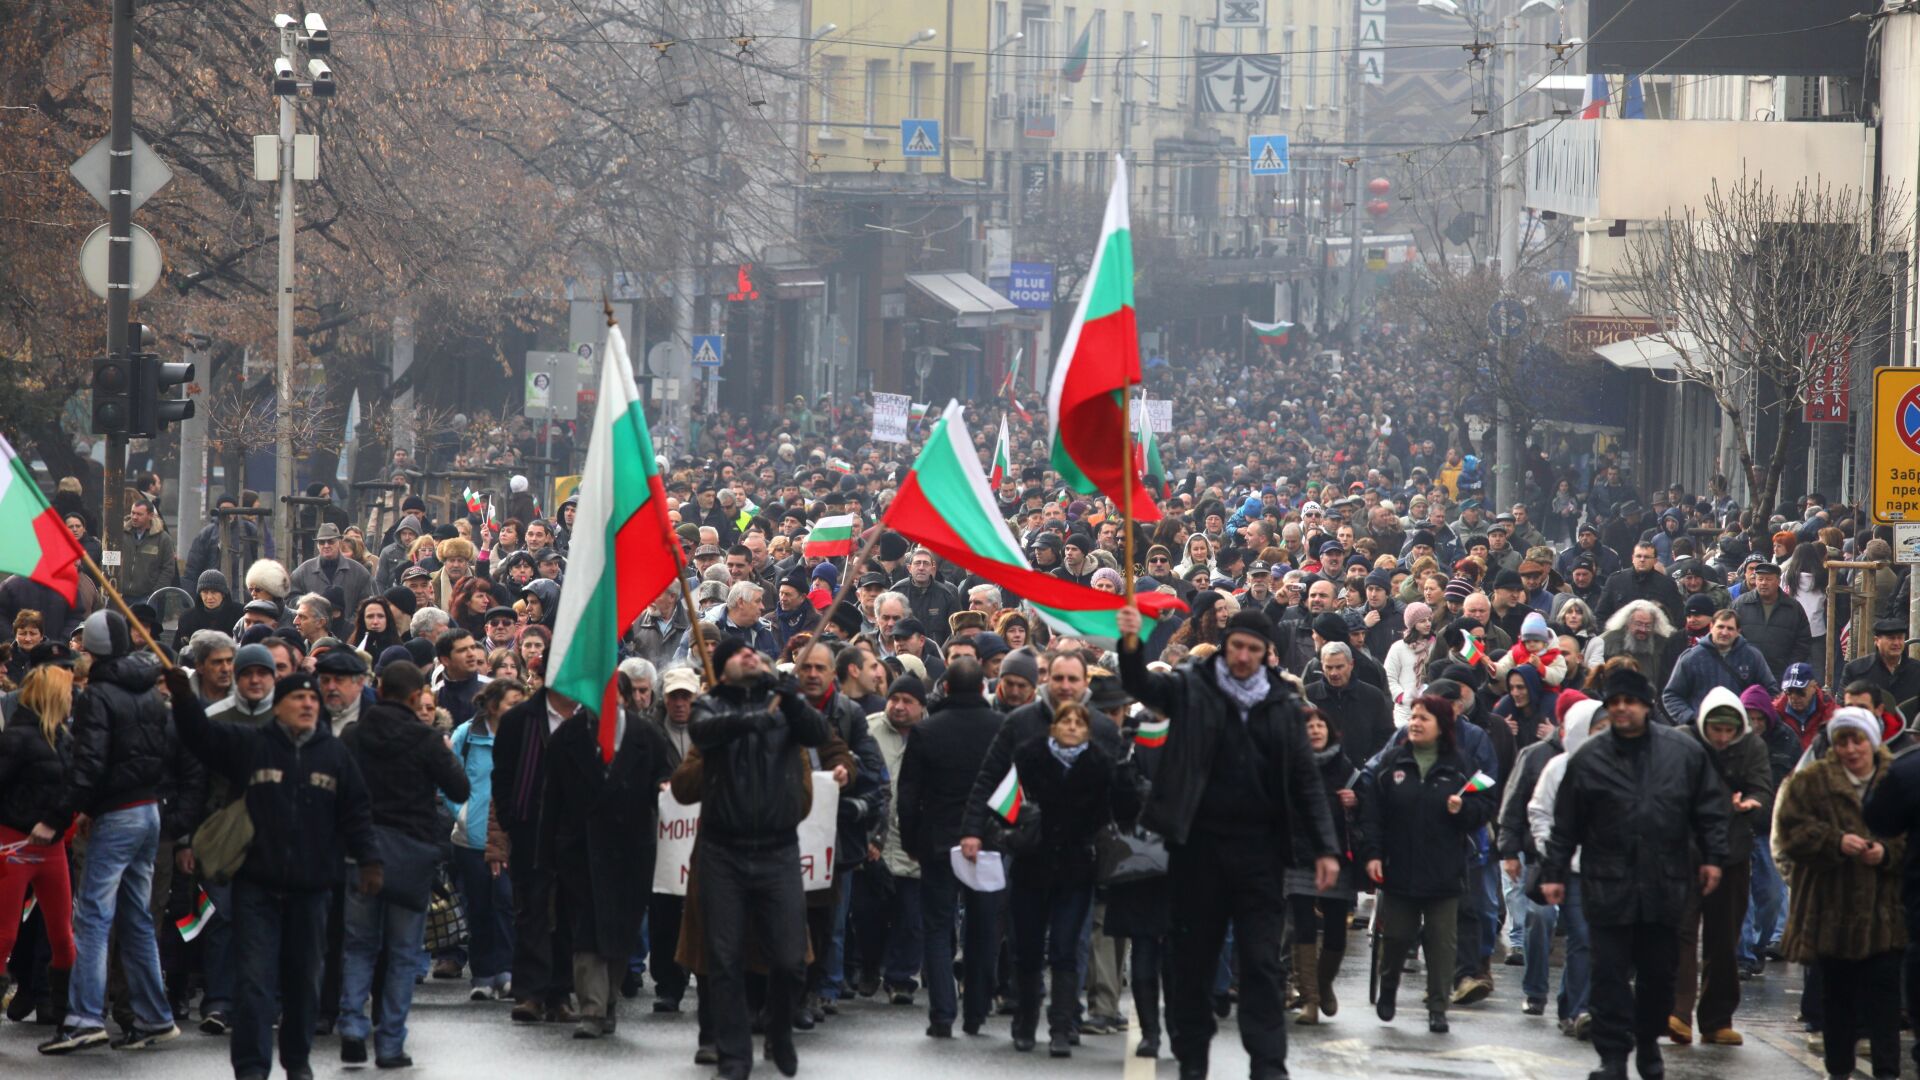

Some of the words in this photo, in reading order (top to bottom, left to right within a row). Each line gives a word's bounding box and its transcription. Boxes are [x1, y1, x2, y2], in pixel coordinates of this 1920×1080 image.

[1361, 0, 1383, 79] ДА
[1015, 278, 1045, 289] BLUE
[1009, 290, 1050, 302] MOON
[1572, 329, 1650, 345] КРИСТ
